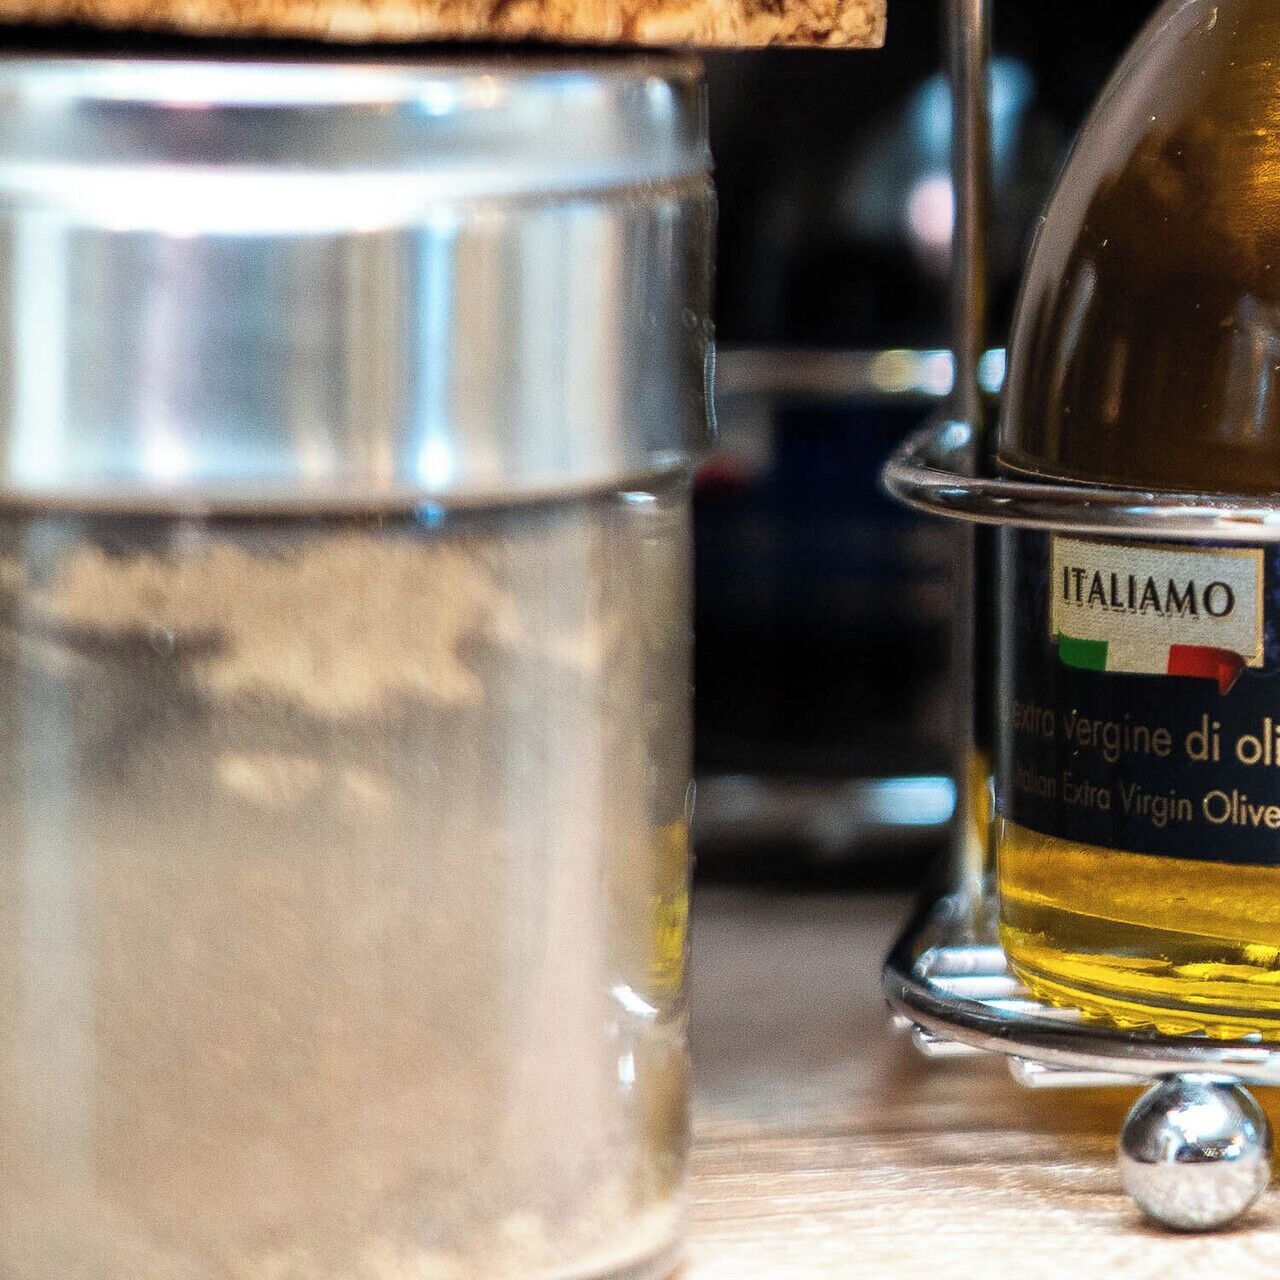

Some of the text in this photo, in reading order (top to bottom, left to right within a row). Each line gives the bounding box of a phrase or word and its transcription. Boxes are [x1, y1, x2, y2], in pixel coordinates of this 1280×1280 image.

[1062, 565, 1236, 619] ITALIAMO
[1064, 712, 1173, 762] vergine
[1185, 713, 1221, 762] di
[1063, 770, 1110, 811] Extra
[1119, 780, 1194, 828] Virgin
